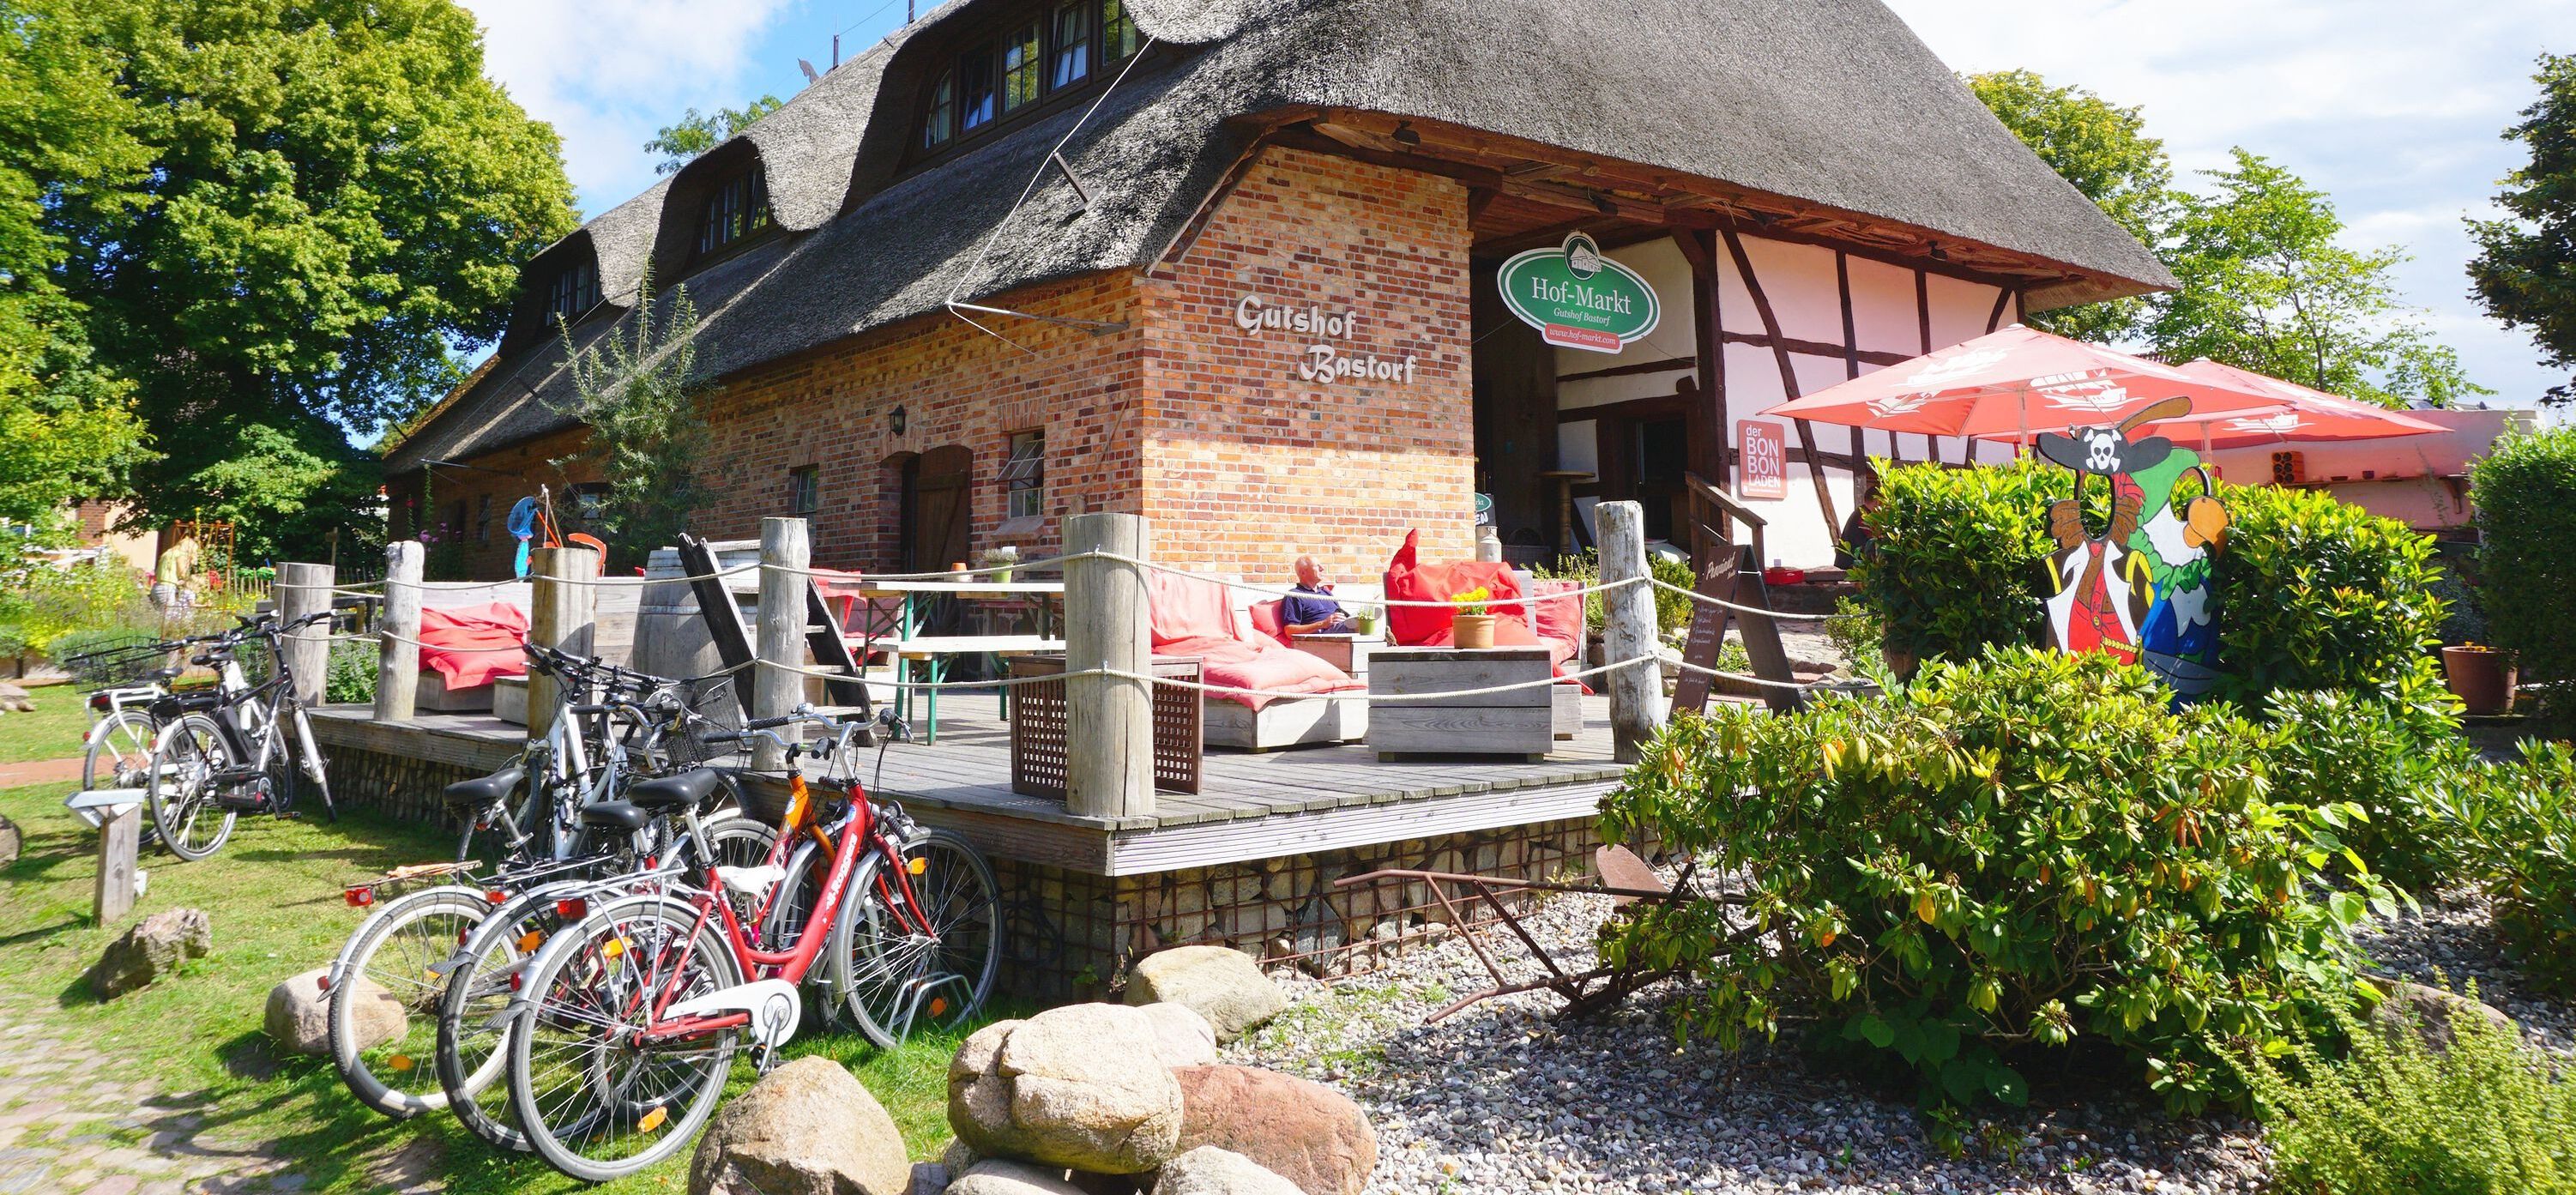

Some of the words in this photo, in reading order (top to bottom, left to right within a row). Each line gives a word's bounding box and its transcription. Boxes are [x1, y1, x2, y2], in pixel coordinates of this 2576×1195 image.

[1531, 276, 1632, 315] Hof-Markt
[1235, 294, 1357, 340] Gutshof
[1553, 307, 1584, 322] Gutshof
[1584, 312, 1611, 327] Bastorf
[1549, 328, 1616, 345] www.hof-markt.com
[1297, 344, 1417, 383] Bastorf
[1746, 425, 1762, 437] der
[1746, 437, 1779, 457] BON
[1747, 456, 1780, 475] BON
[1748, 474, 1782, 488] LADEN
[1475, 511, 1488, 526] EN
